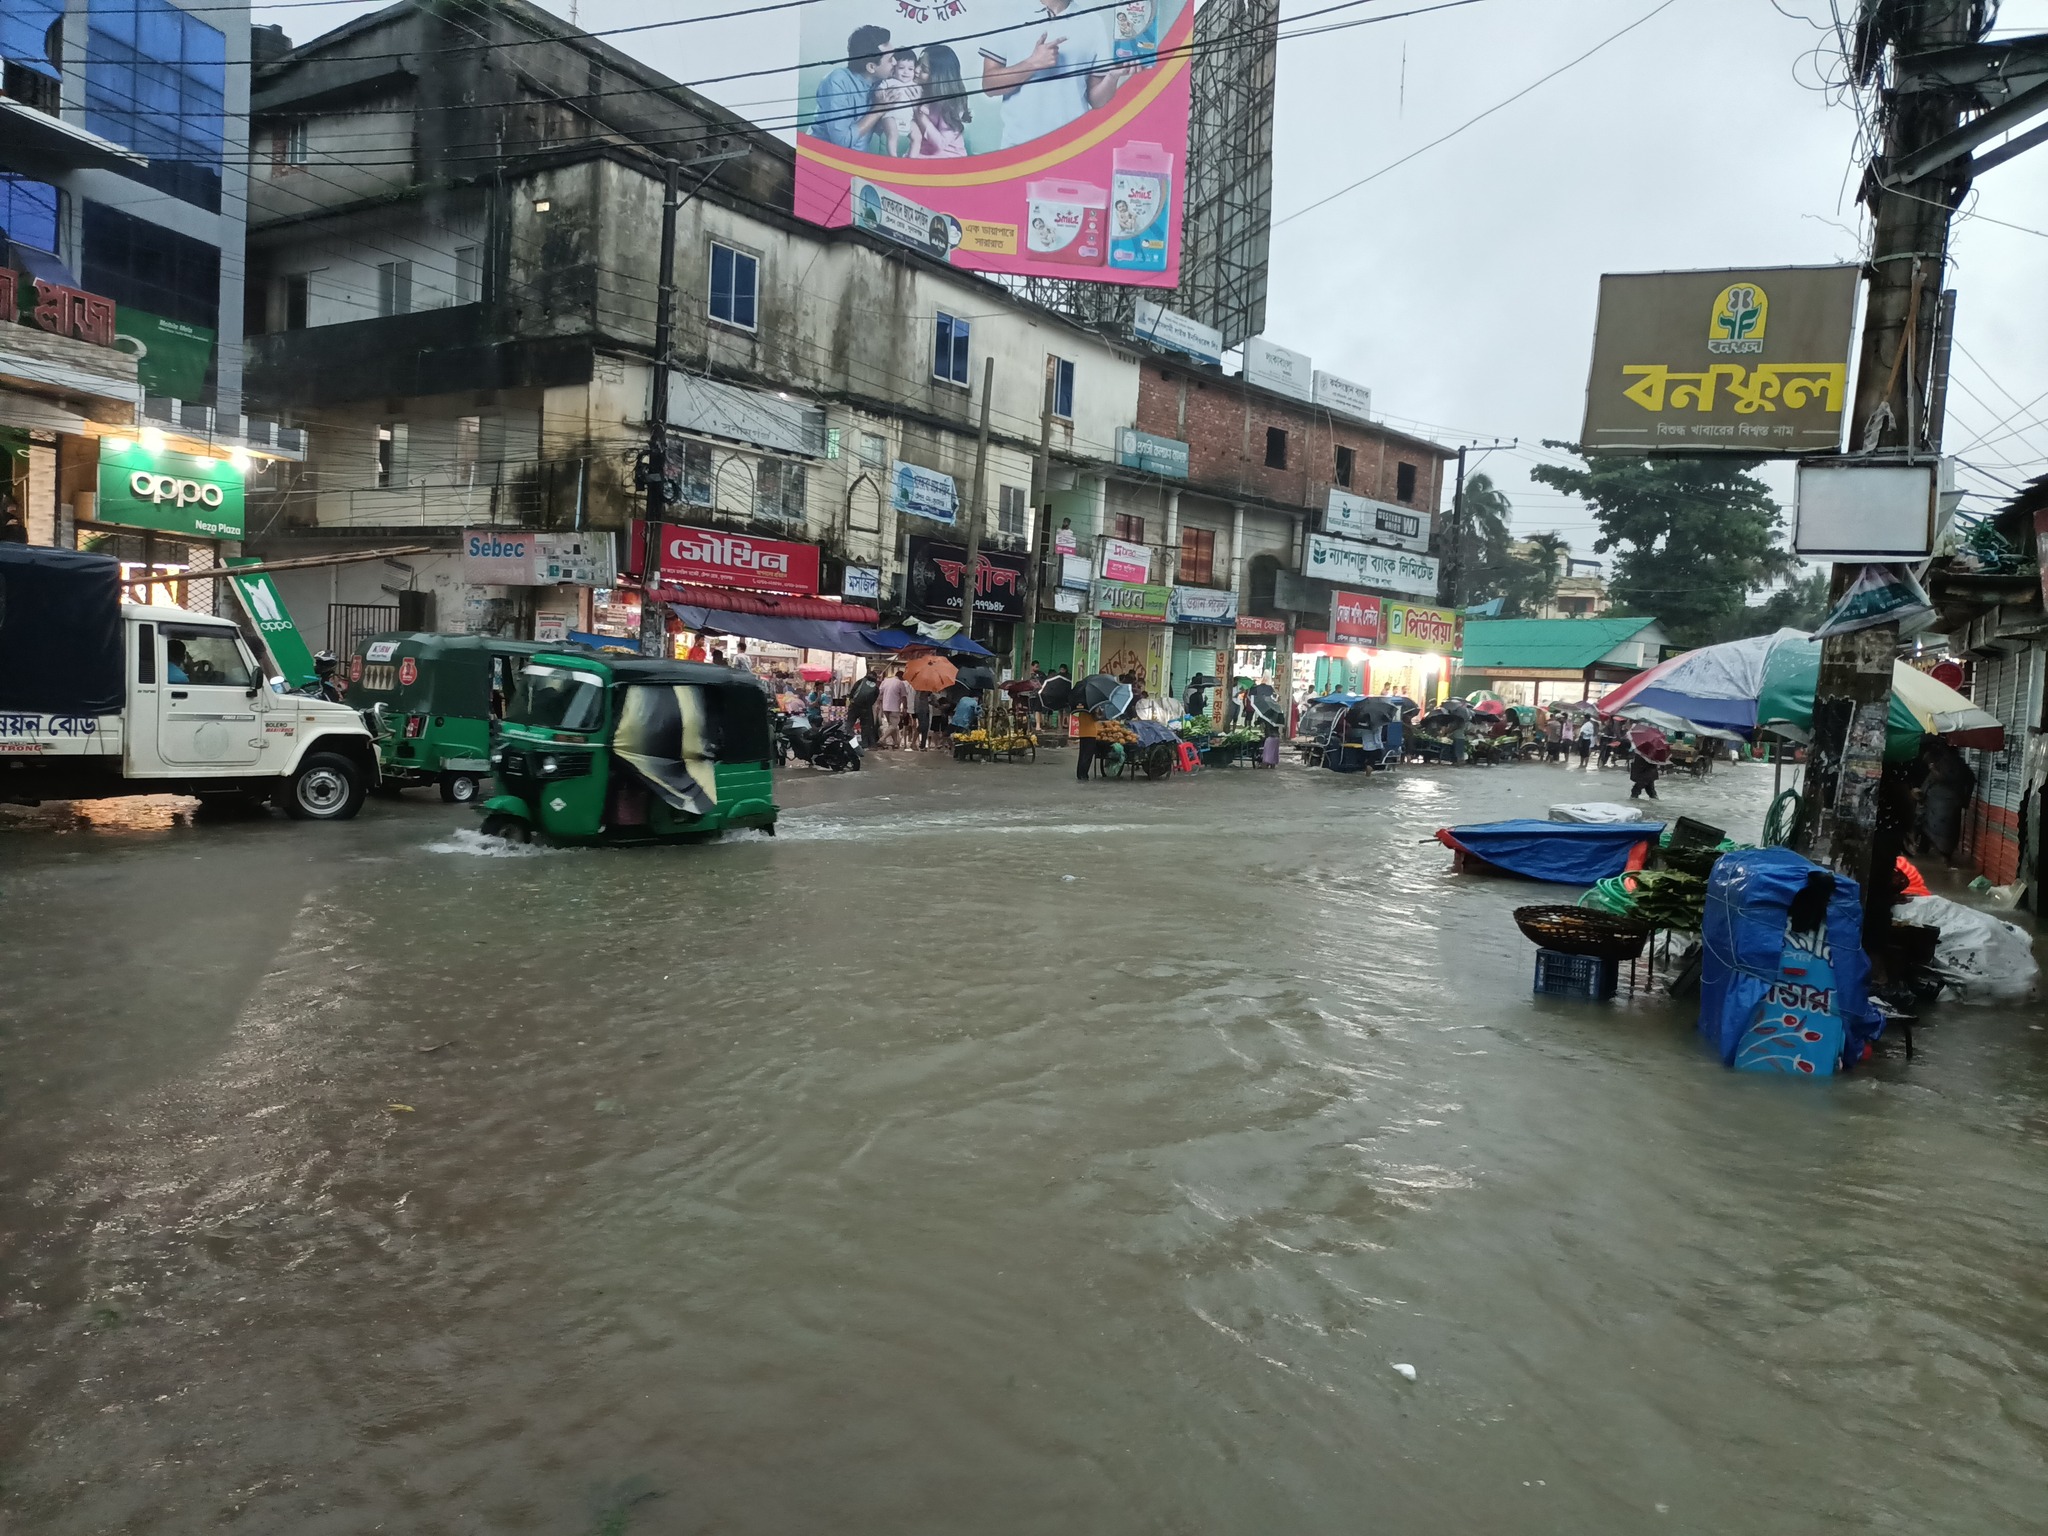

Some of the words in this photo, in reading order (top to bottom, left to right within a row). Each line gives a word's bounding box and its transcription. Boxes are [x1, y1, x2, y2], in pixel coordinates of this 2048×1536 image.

[966, 225, 979, 234] এক
[975, 237, 1004, 249] সারারাত
[33, 277, 116, 346] প্লাজা
[1622, 362, 1847, 414] বনফুল
[1657, 422, 1686, 436] বিশুদ্ধ
[1690, 424, 1734, 436] খাবারের
[1773, 425, 1794, 436] নাম
[131, 471, 223, 507] oppo
[195, 520, 217, 533] Neza
[218, 523, 241, 535] Plaza
[469, 536, 525, 558] Sebec
[669, 533, 790, 573] সৌখিন
[1122, 546, 1136, 557] brac
[1329, 547, 1368, 571] ন্যাশনাল
[1371, 555, 1396, 575] ব্যাংক
[1399, 556, 1434, 580] লিমিটেড
[848, 571, 878, 596] মসজিদ
[946, 596, 1005, 612] ০১৭-৭৭৭৯৪৮
[260, 621, 293, 633] oppo
[0, 744, 42, 752] TRONG
